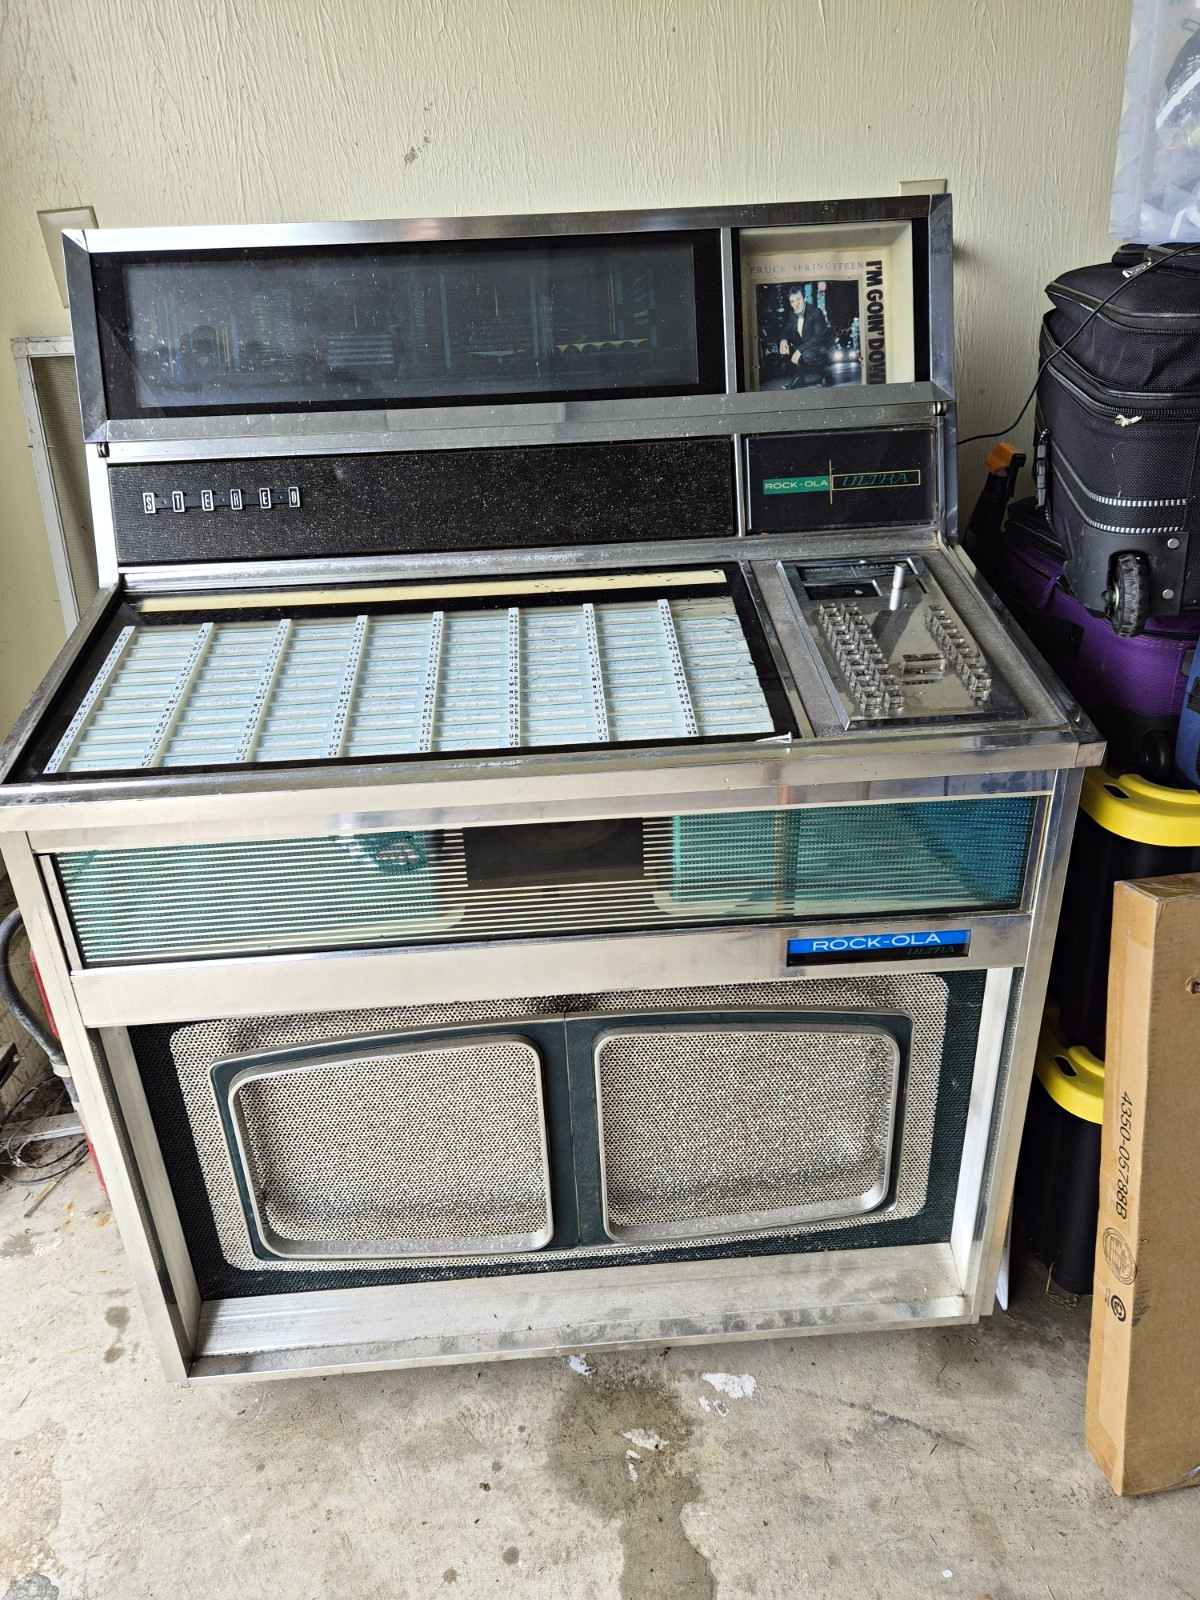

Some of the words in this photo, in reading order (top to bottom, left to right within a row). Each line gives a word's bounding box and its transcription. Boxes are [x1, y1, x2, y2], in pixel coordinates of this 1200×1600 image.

[793, 261, 865, 272] SPRINGSTEEN
[865, 260, 883, 288] I'M
[866, 289, 885, 336] GOIN'
[842, 472, 910, 487] ULTRA
[145, 489, 298, 511] STEREO
[812, 932, 941, 952] ROCK-OLA
[1115, 1090, 1133, 1221] 4350-05788B
